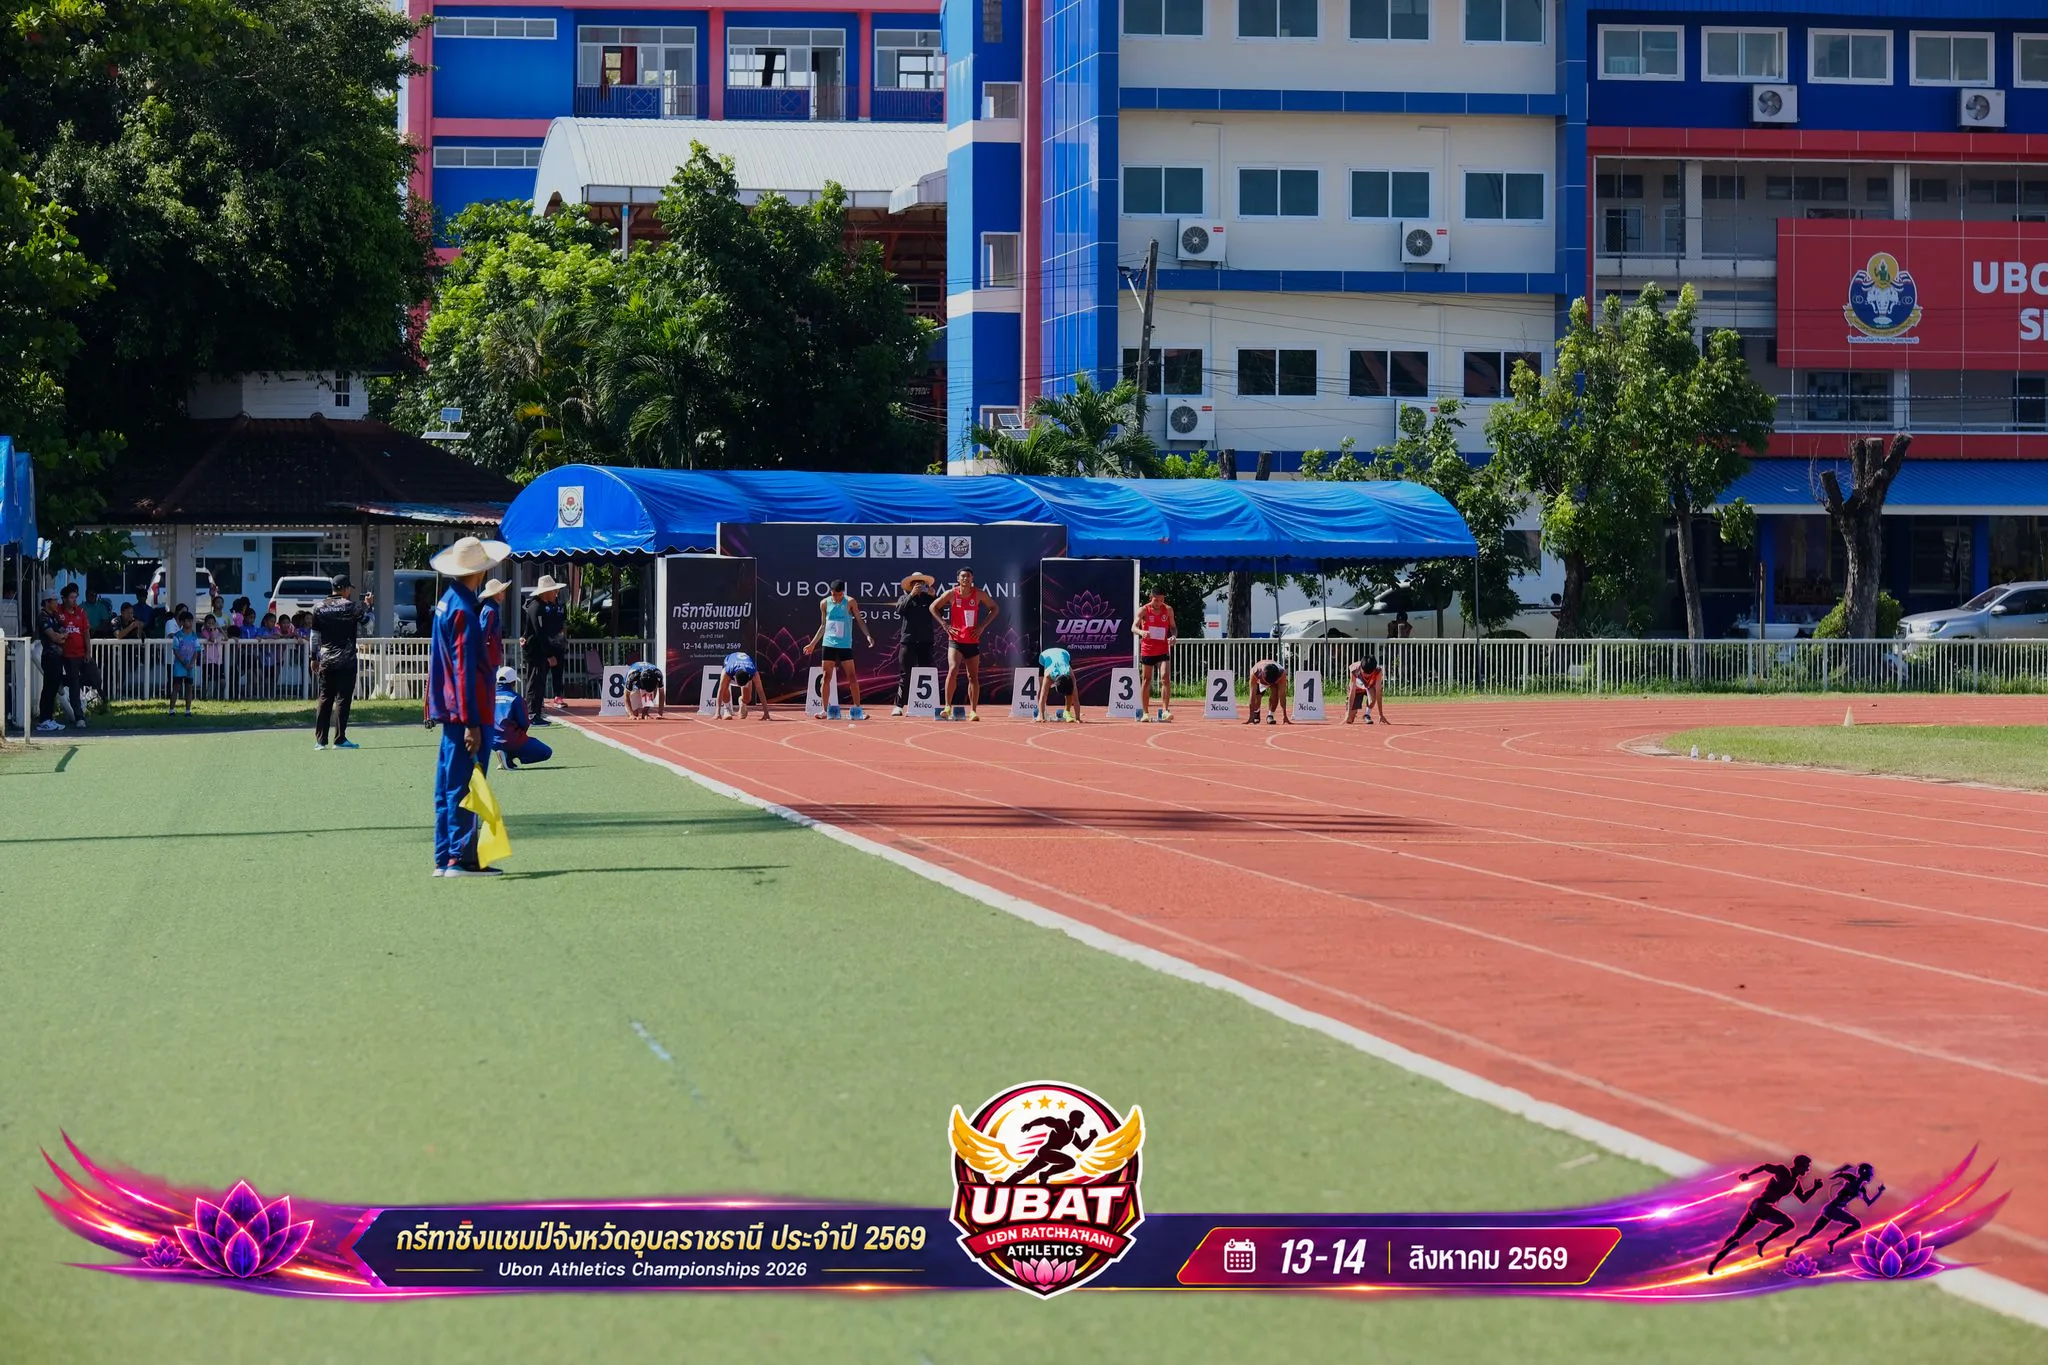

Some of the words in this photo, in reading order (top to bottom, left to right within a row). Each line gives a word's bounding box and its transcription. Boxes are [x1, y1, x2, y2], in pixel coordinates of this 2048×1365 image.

[2020, 308, 2048, 341] S
[1056, 619, 1122, 635] UBON
[609, 673, 625, 698] 8
[916, 675, 932, 700] 5
[1021, 675, 1037, 700] 4
[1118, 675, 1134, 701] 3
[1213, 677, 1228, 702] 2
[1302, 678, 1315, 703] 1
